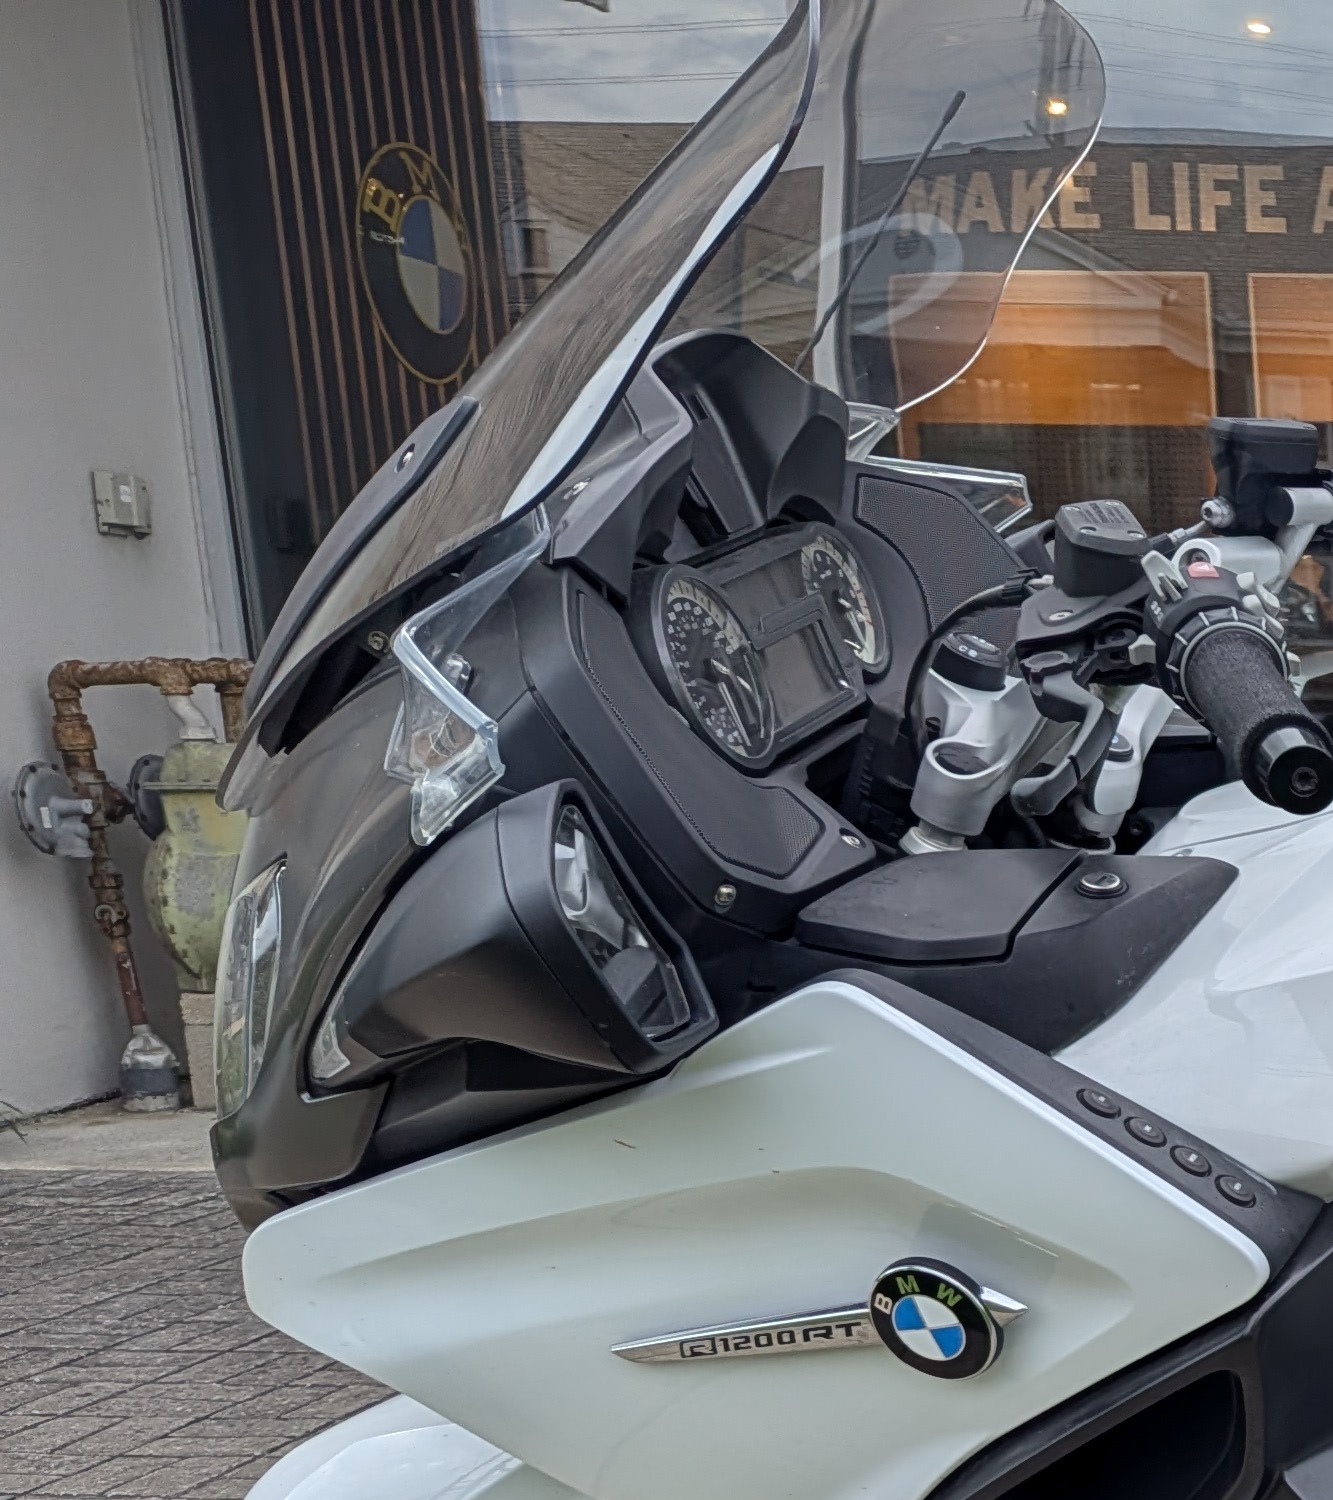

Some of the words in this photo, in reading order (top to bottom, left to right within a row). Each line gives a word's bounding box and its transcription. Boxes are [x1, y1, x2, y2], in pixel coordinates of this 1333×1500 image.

[902, 162, 1100, 234] MAKE
[1131, 162, 1288, 234] LIFE
[873, 1275, 963, 1315] BMW
